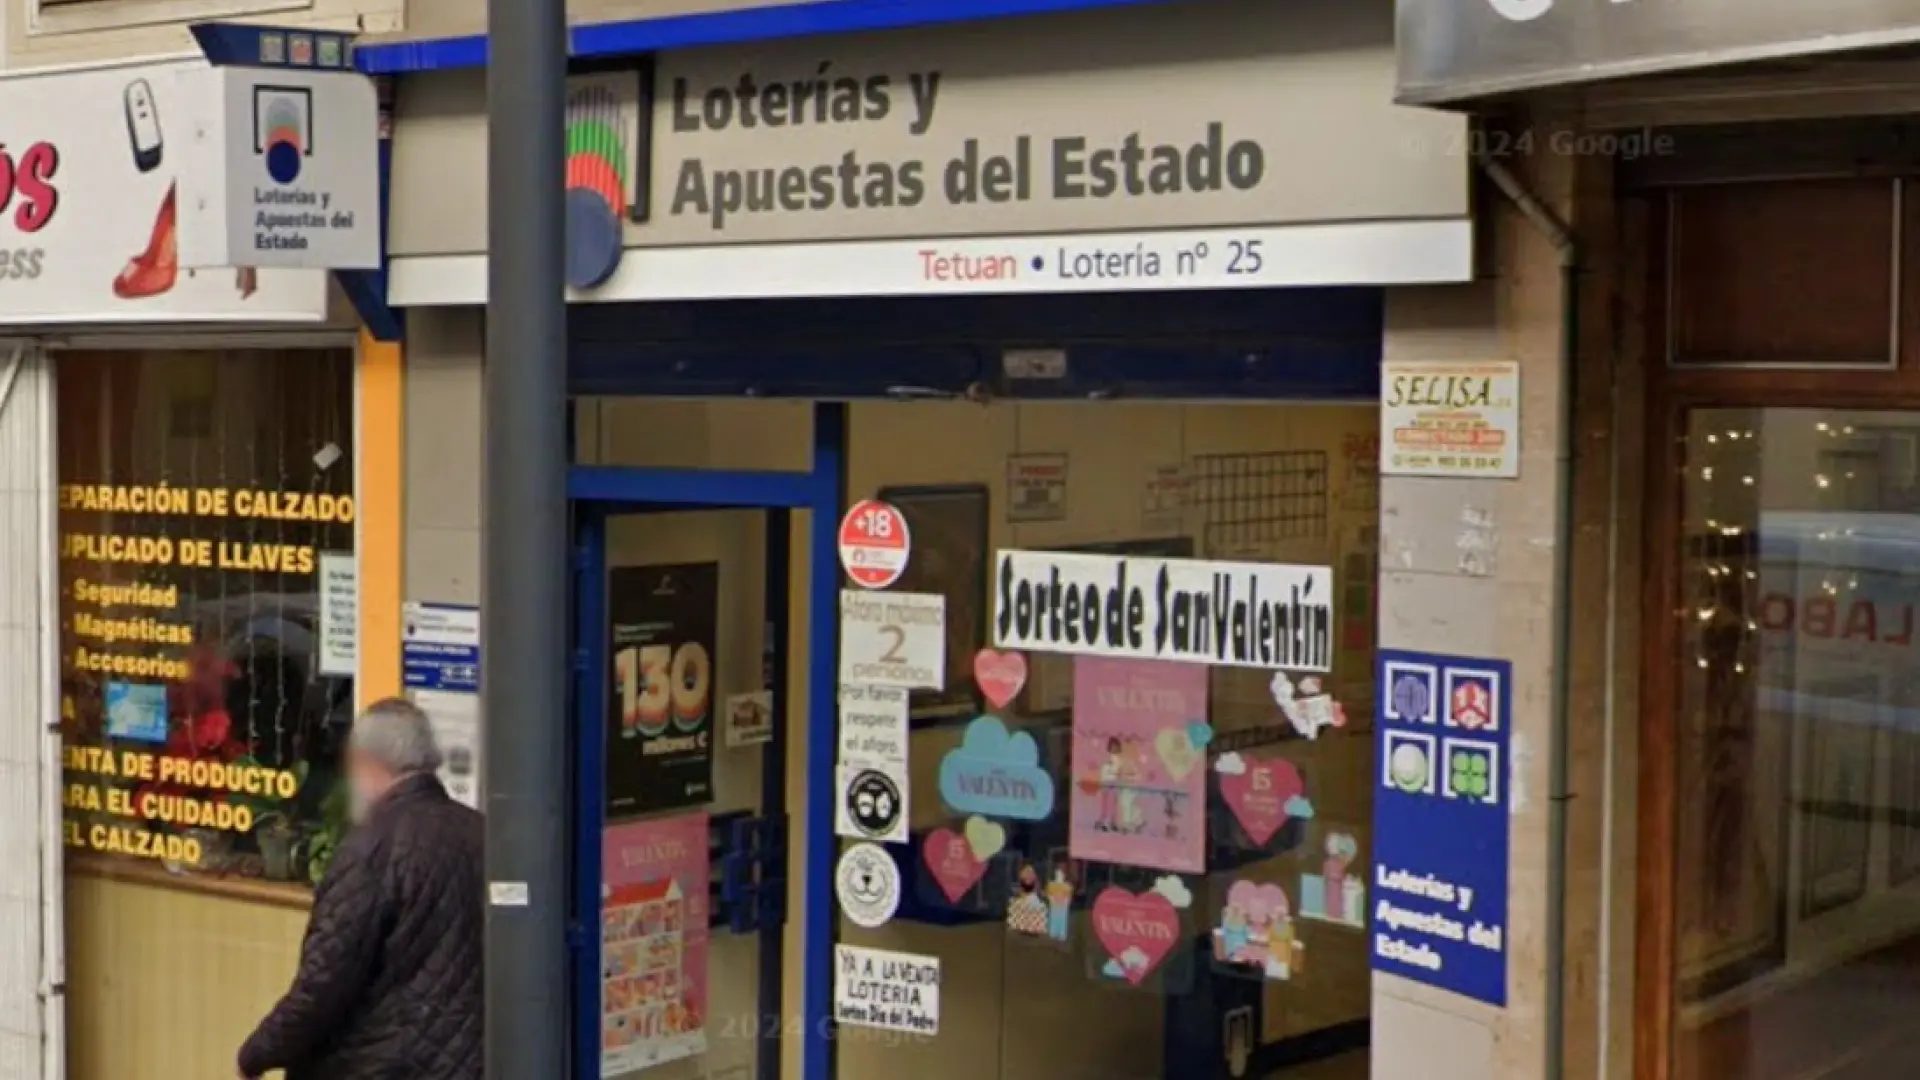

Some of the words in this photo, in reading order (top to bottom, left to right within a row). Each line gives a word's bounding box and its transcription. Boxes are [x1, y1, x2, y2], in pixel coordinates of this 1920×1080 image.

[672, 62, 890, 132] Loterías
[908, 68, 942, 136] y
[671, 151, 924, 229] Apuestas
[945, 136, 1030, 204] del
[1052, 122, 1265, 198] Estado
[255, 211, 326, 231] Apuestas
[330, 211, 353, 228] del
[255, 232, 308, 249] Estado
[919, 250, 1017, 281] Tetuan
[1059, 243, 1160, 279] Lotería
[1177, 241, 1209, 275] nº
[1226, 240, 1263, 275] 25
[1386, 376, 1491, 407] SELISA
[195, 489, 229, 516] DE
[234, 489, 354, 523] CALZADO
[854, 509, 892, 537] +18
[179, 540, 212, 567] DE
[218, 541, 314, 573] LLAVES
[74, 577, 177, 608] Seguridad
[74, 612, 192, 643] Magnéticas
[878, 625, 908, 665] 2
[76, 647, 188, 679] Accesorios
[614, 642, 710, 738] 130
[62, 695, 75, 719] A
[846, 711, 897, 730] respete
[846, 736, 858, 750] el
[122, 751, 153, 780] DE
[160, 756, 297, 799] PRODUCTO
[107, 788, 136, 815] EL
[142, 793, 251, 832] CUIDADO
[90, 824, 201, 863] CALZADO
[1376, 932, 1441, 971] Estado
[1467, 919, 1501, 952] del
[841, 950, 856, 975] YA
[863, 958, 873, 978] A
